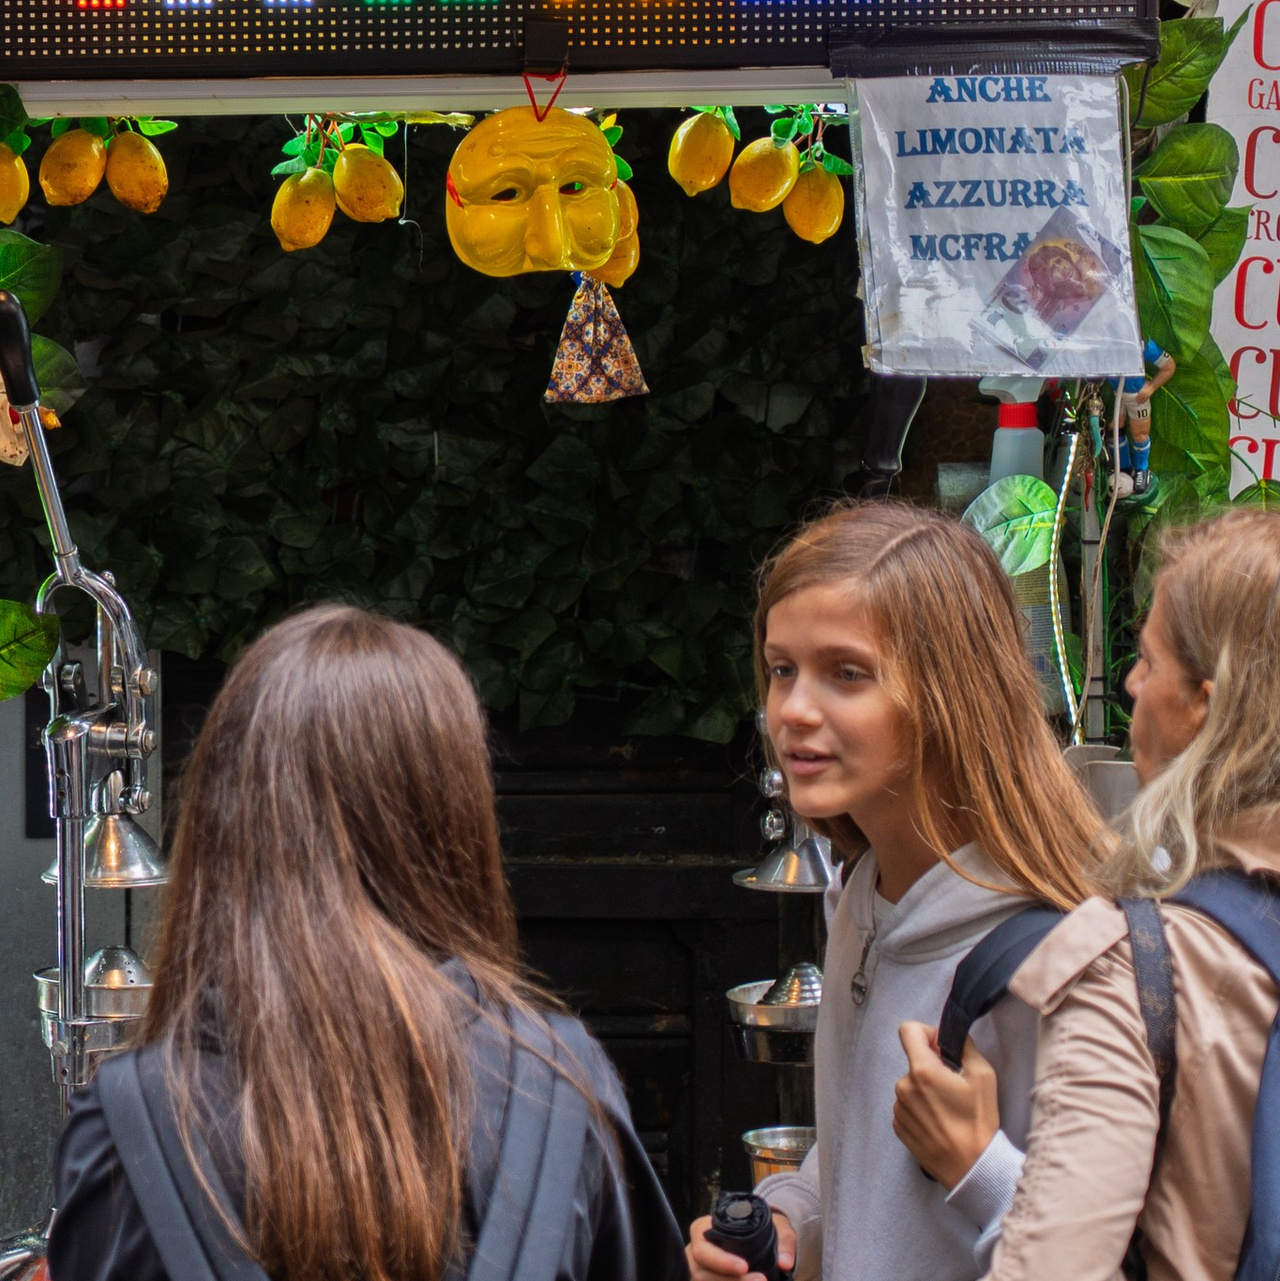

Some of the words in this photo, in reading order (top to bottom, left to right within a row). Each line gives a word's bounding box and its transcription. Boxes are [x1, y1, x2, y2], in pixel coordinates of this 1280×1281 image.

[926, 76, 1052, 103] ANCHE
[894, 127, 1090, 158] LIMONATA
[904, 179, 1090, 209] AZZURRA
[1136, 408, 1148, 419] 10
